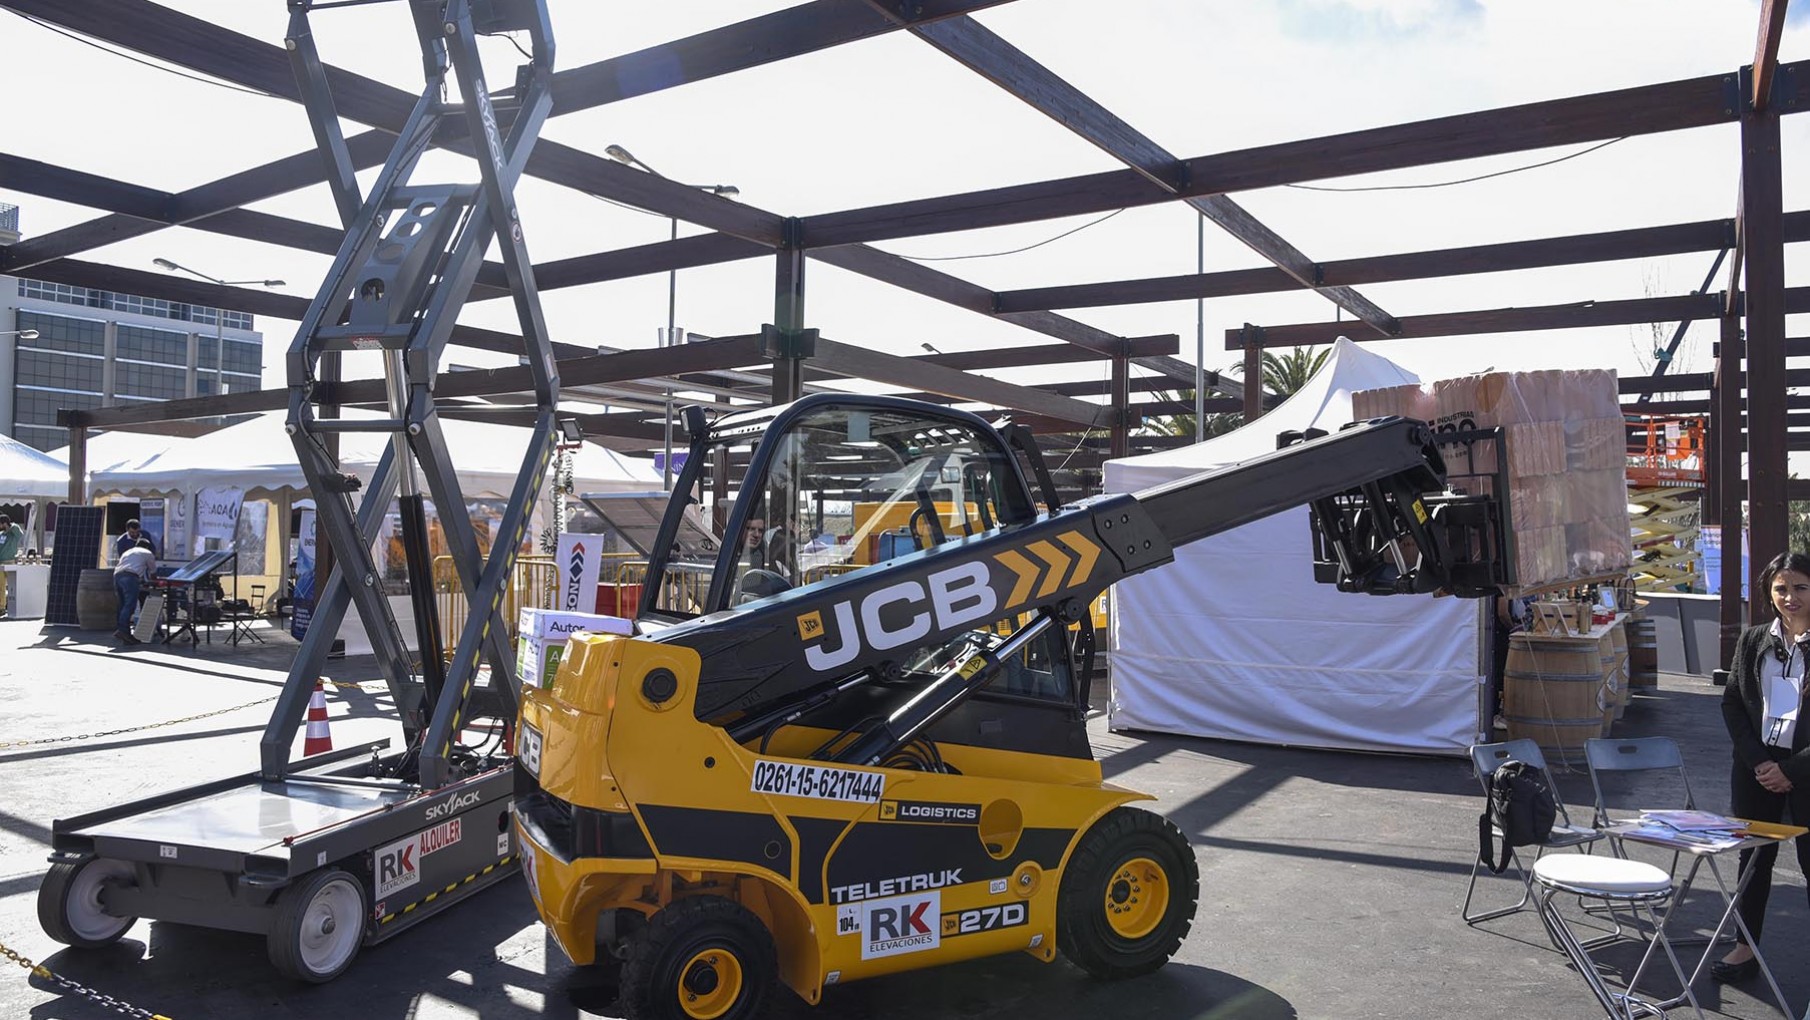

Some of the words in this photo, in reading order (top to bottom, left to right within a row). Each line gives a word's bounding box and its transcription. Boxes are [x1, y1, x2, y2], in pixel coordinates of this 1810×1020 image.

[476, 79, 503, 171] SKYJACK
[801, 617, 819, 634] JCB
[804, 561, 997, 671] JCB
[754, 762, 882, 802] 0261-15-6217444
[425, 791, 480, 820] SKYJACK
[901, 806, 976, 819] LOGISTICS
[420, 819, 460, 856] ALQUILER
[380, 843, 416, 884] RK
[380, 873, 416, 893] ELEVACIONES
[831, 868, 963, 903] TELETRUK
[839, 916, 854, 932] 104
[870, 901, 932, 942] RK
[960, 903, 1025, 933] 27D
[869, 935, 933, 953] ELEVACIONES
